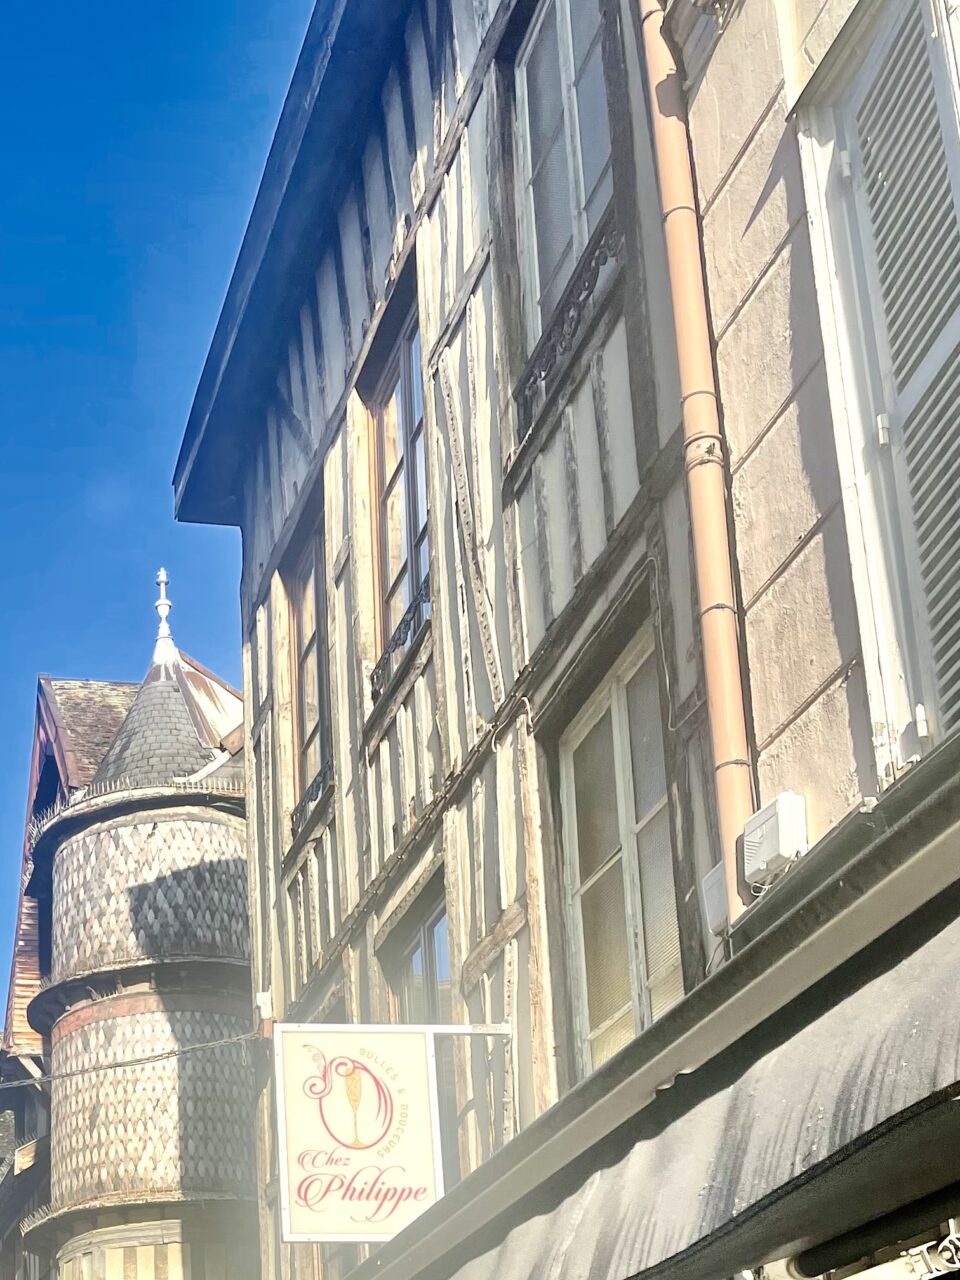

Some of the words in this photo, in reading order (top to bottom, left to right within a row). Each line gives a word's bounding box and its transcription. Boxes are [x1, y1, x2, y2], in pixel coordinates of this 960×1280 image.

[376, 1103, 409, 1159] DOUCEURS
[297, 1147, 351, 1173] Chez
[295, 1165, 429, 1223] Philippe
